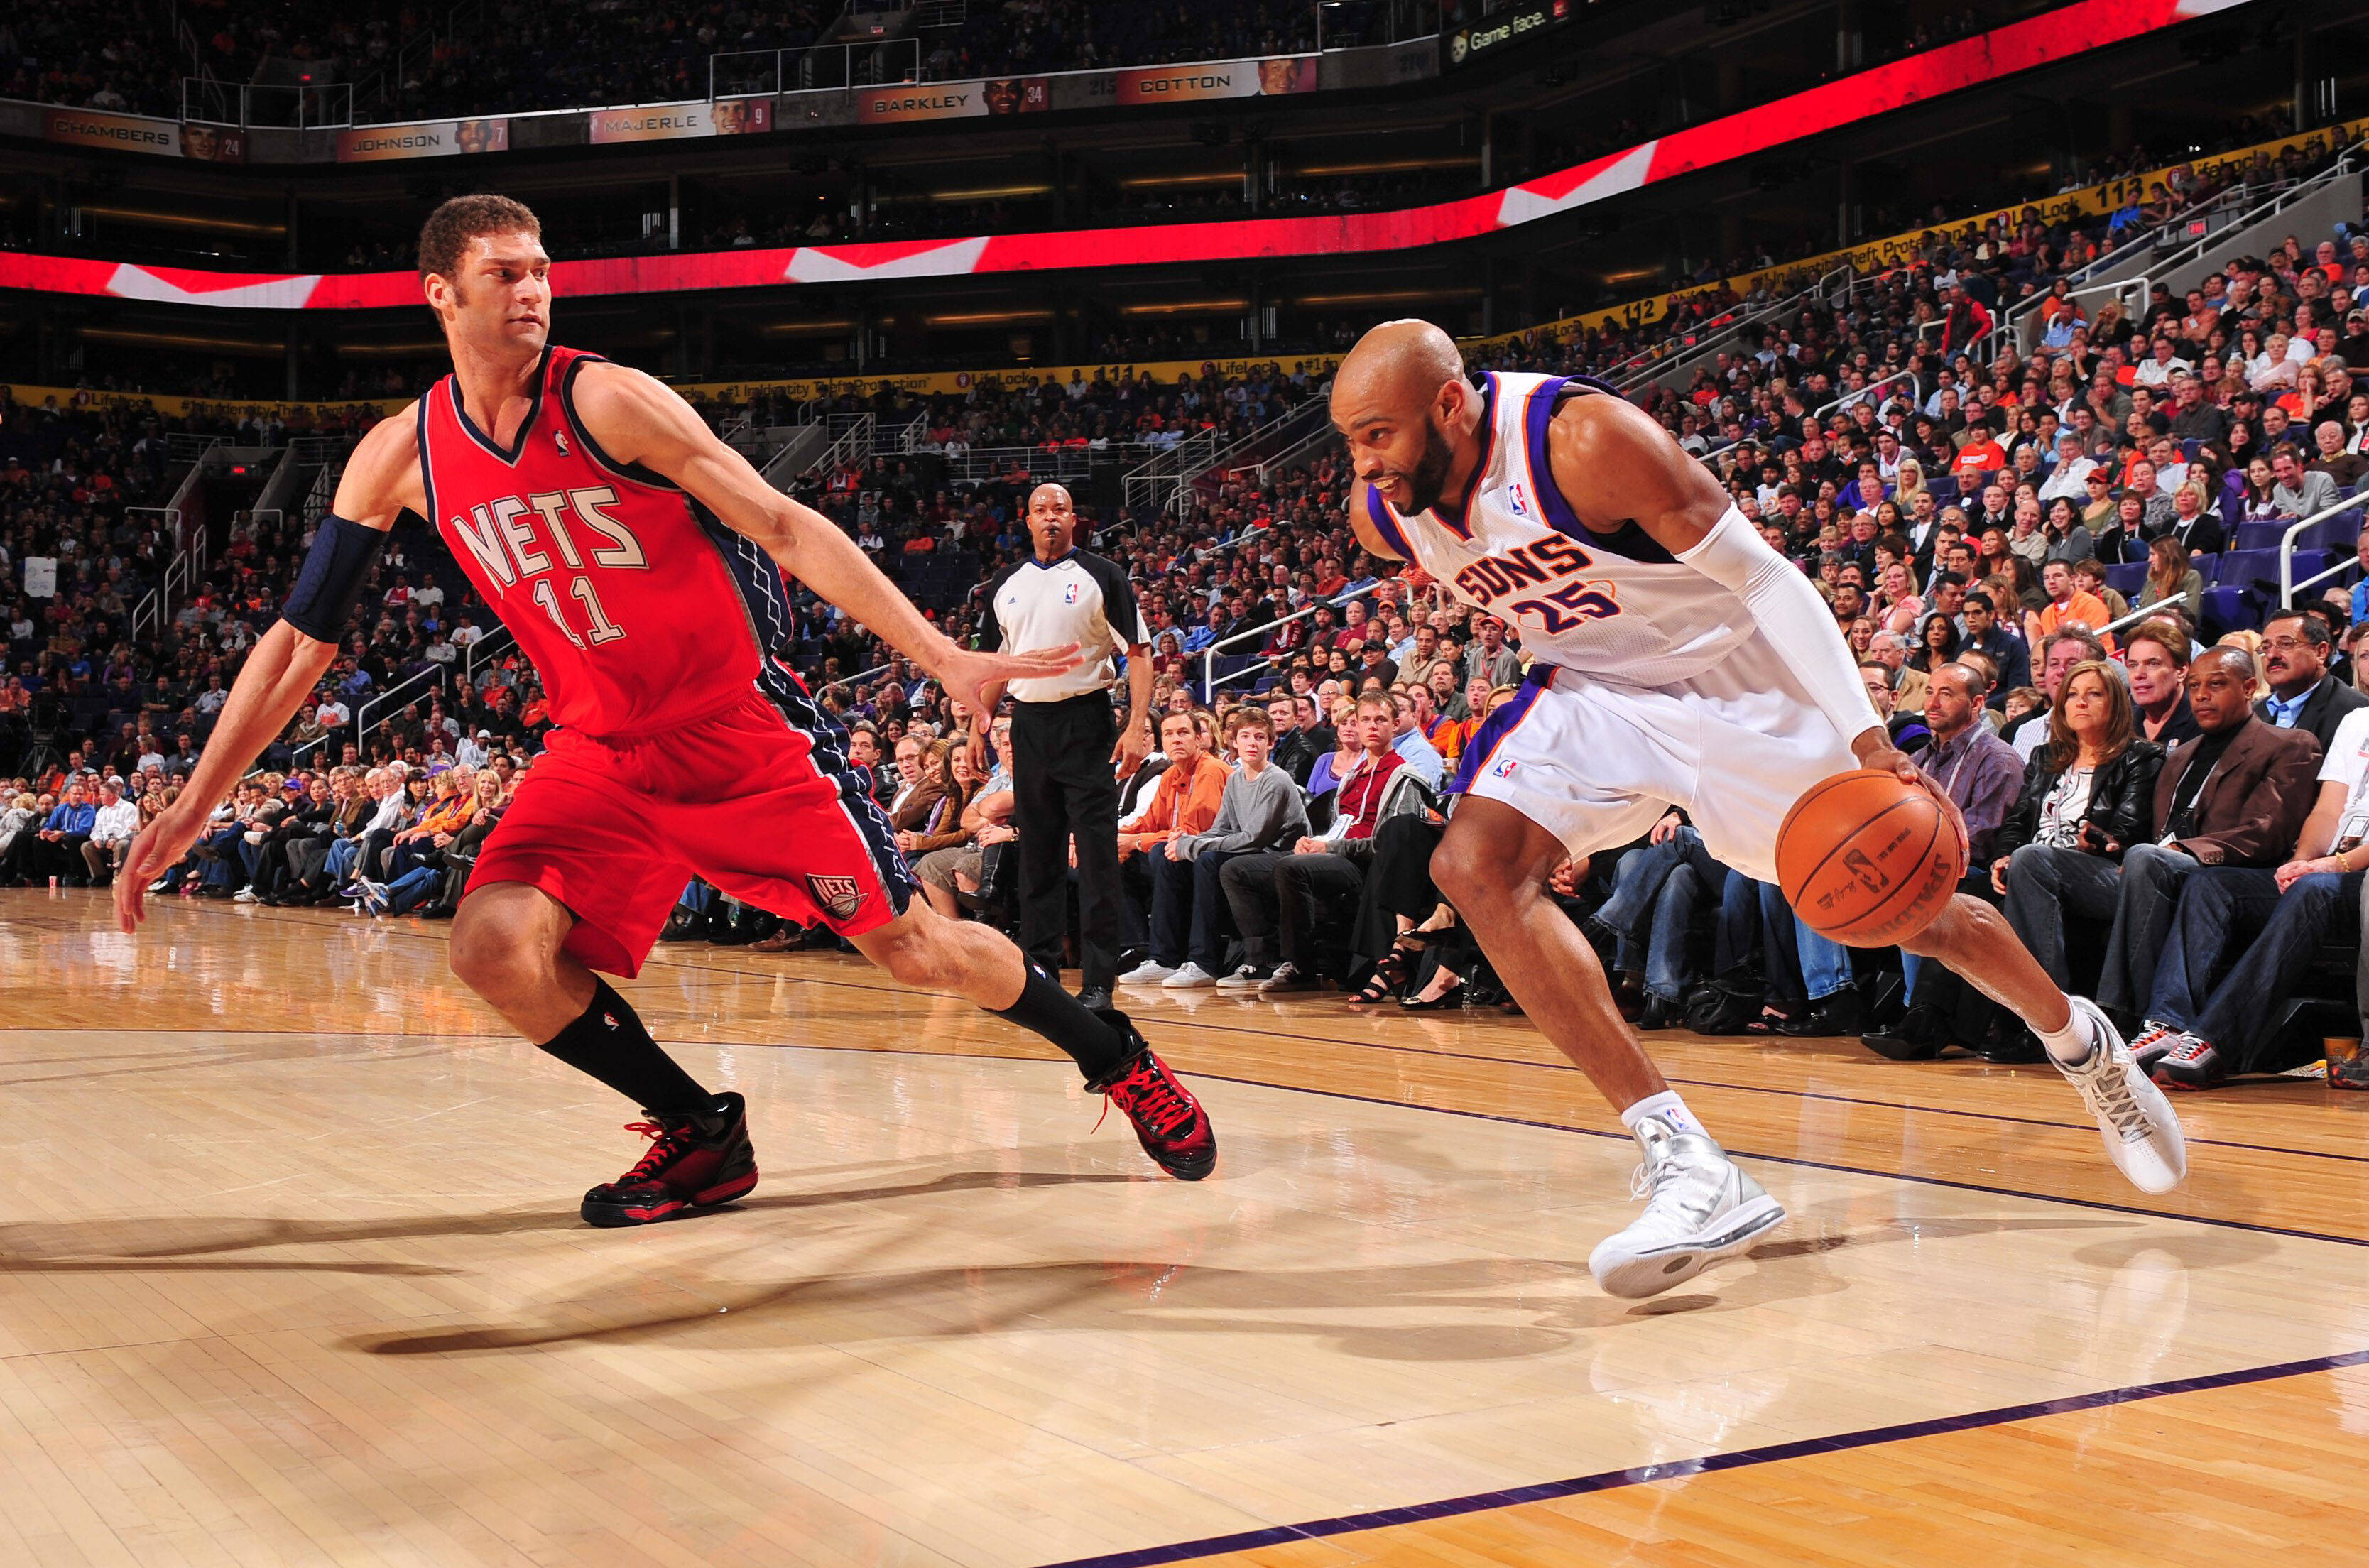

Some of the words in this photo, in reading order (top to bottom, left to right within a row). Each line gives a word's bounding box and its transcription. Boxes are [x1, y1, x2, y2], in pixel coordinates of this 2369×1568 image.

[1470, 24, 1510, 51] Game
[1513, 11, 1546, 34] face.
[1089, 79, 1116, 96] 215
[1140, 75, 1231, 93] COTTON
[874, 94, 969, 114] BARKLEY
[1028, 86, 1042, 104] 34
[604, 115, 697, 133] MAJERLE
[754, 108, 763, 124] 9
[55, 120, 170, 146] CHAMBERS
[496, 126, 503, 143] 7
[224, 138, 239, 156] 24
[352, 134, 440, 152] JOHNSON
[1623, 300, 1654, 327] 112
[1099, 365, 1134, 381] 111
[450, 485, 649, 599] NETS
[1454, 533, 1594, 607] SUNS
[533, 576, 626, 649] 11
[1509, 580, 1622, 635] 25
[812, 877, 856, 905] NETS
